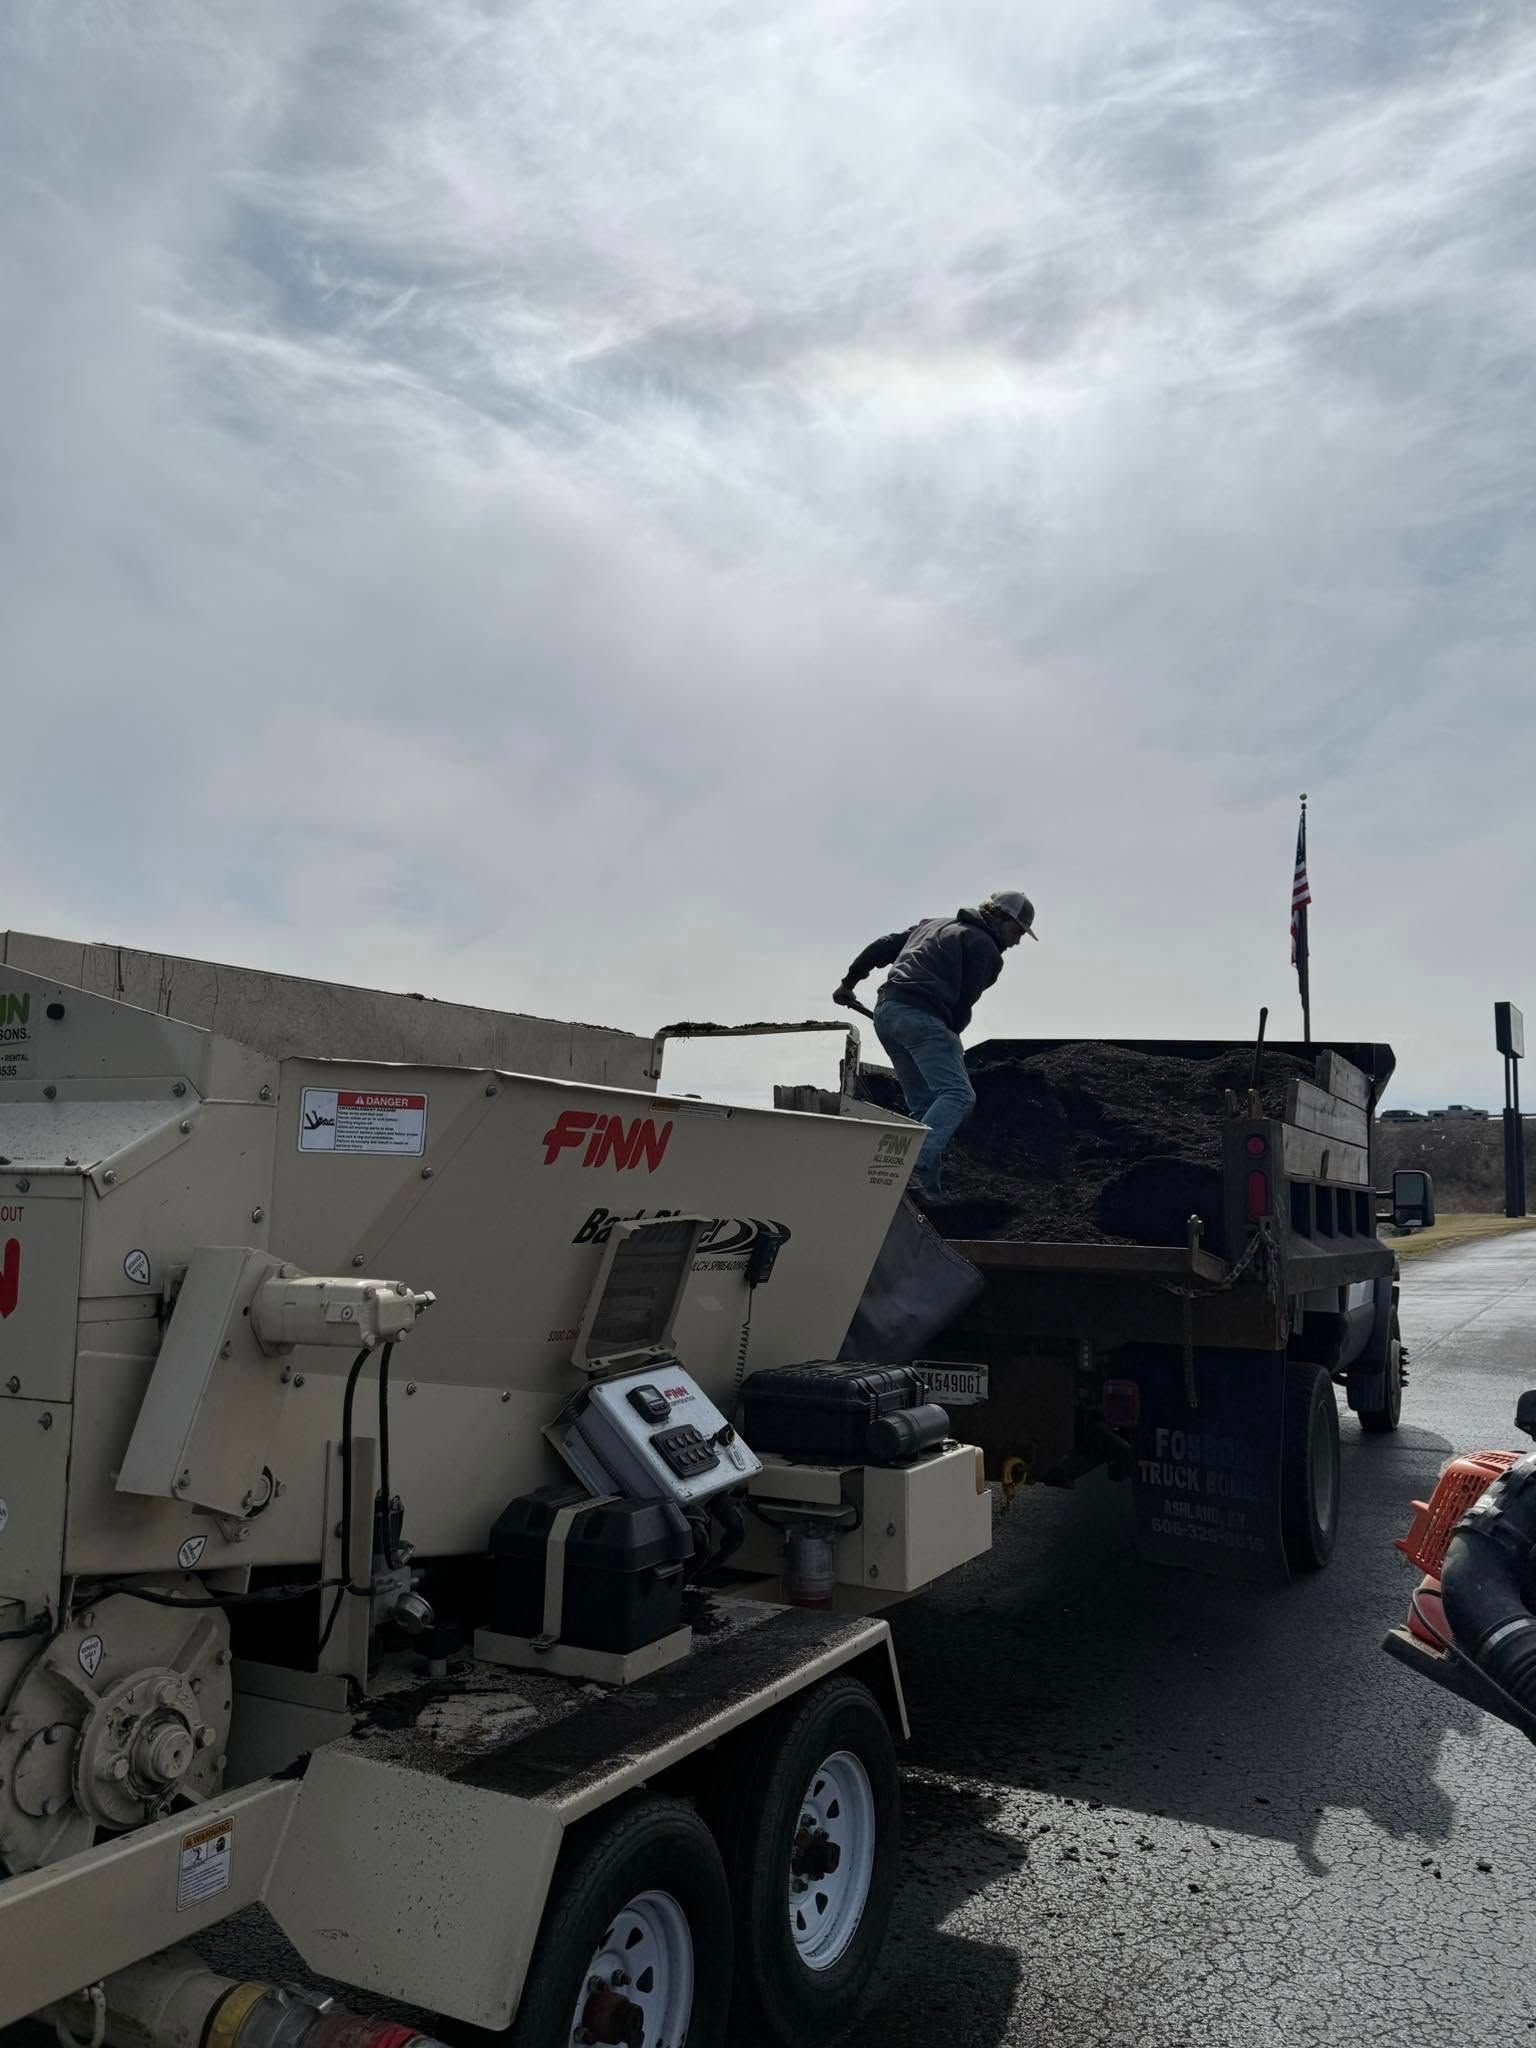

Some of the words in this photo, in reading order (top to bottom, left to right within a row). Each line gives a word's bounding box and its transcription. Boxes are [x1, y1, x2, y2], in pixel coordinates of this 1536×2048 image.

[366, 1096, 409, 1107] DANGER
[877, 1134, 912, 1157] FINN
[663, 1385, 690, 1401] FINN
[1138, 1459, 1200, 1492] TRUCK
[193, 1822, 230, 1846] WARNING
